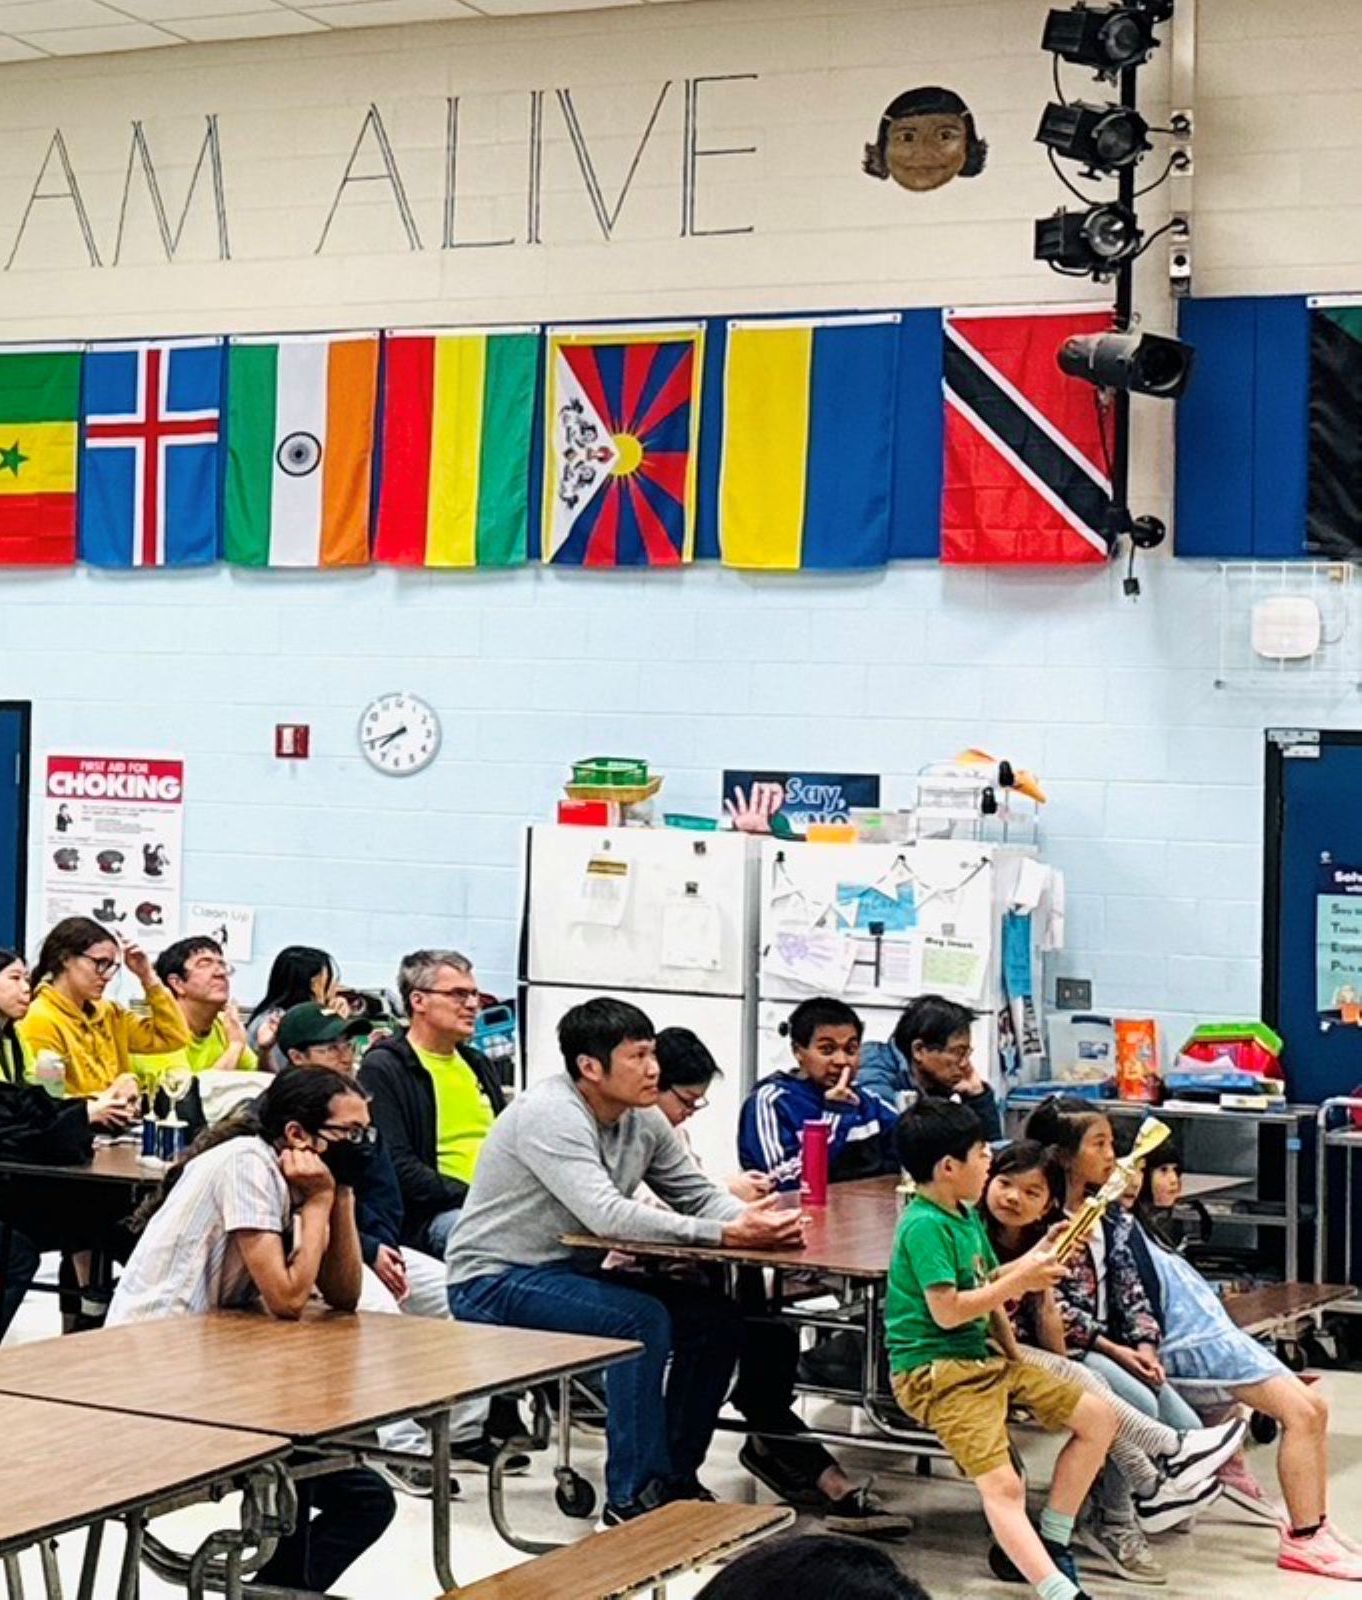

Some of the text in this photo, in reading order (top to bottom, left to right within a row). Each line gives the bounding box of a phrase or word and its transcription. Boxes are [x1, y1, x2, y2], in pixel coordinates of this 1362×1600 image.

[314, 73, 758, 254] ALIVE
[80, 760, 149, 774] FIRST AID FOR
[48, 771, 181, 800] CHOKING
[785, 777, 846, 812] Say,
